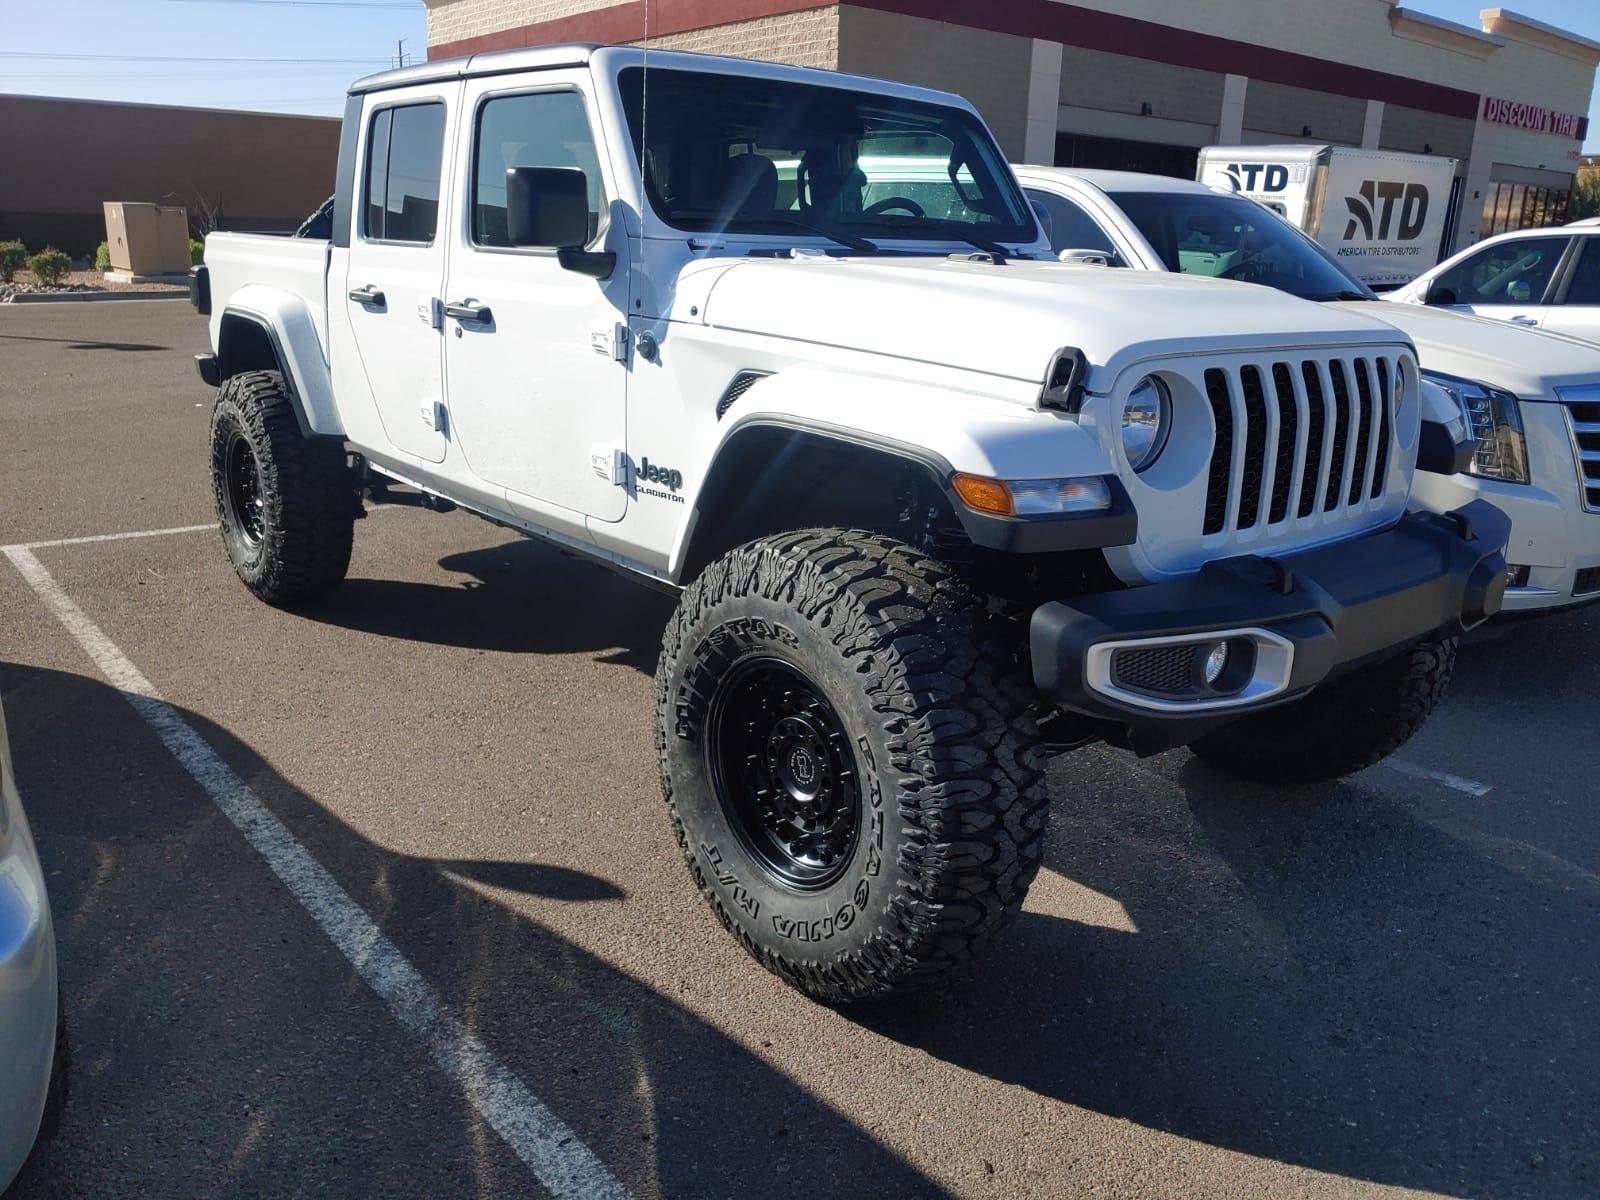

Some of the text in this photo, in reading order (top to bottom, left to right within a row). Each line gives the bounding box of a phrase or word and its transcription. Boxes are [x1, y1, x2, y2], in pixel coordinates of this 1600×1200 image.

[1487, 99, 1579, 138] DISCOUNT TIRE
[1216, 163, 1289, 192] ATD
[1343, 180, 1429, 241] ATD
[1337, 246, 1420, 256] AMERICAN TIRE DISTRIBUTORS
[636, 457, 683, 493] Jeep
[635, 485, 686, 504] GLADIATOR
[675, 616, 800, 739] MILESTAR
[701, 734, 884, 942] PATAGONIA M/T
